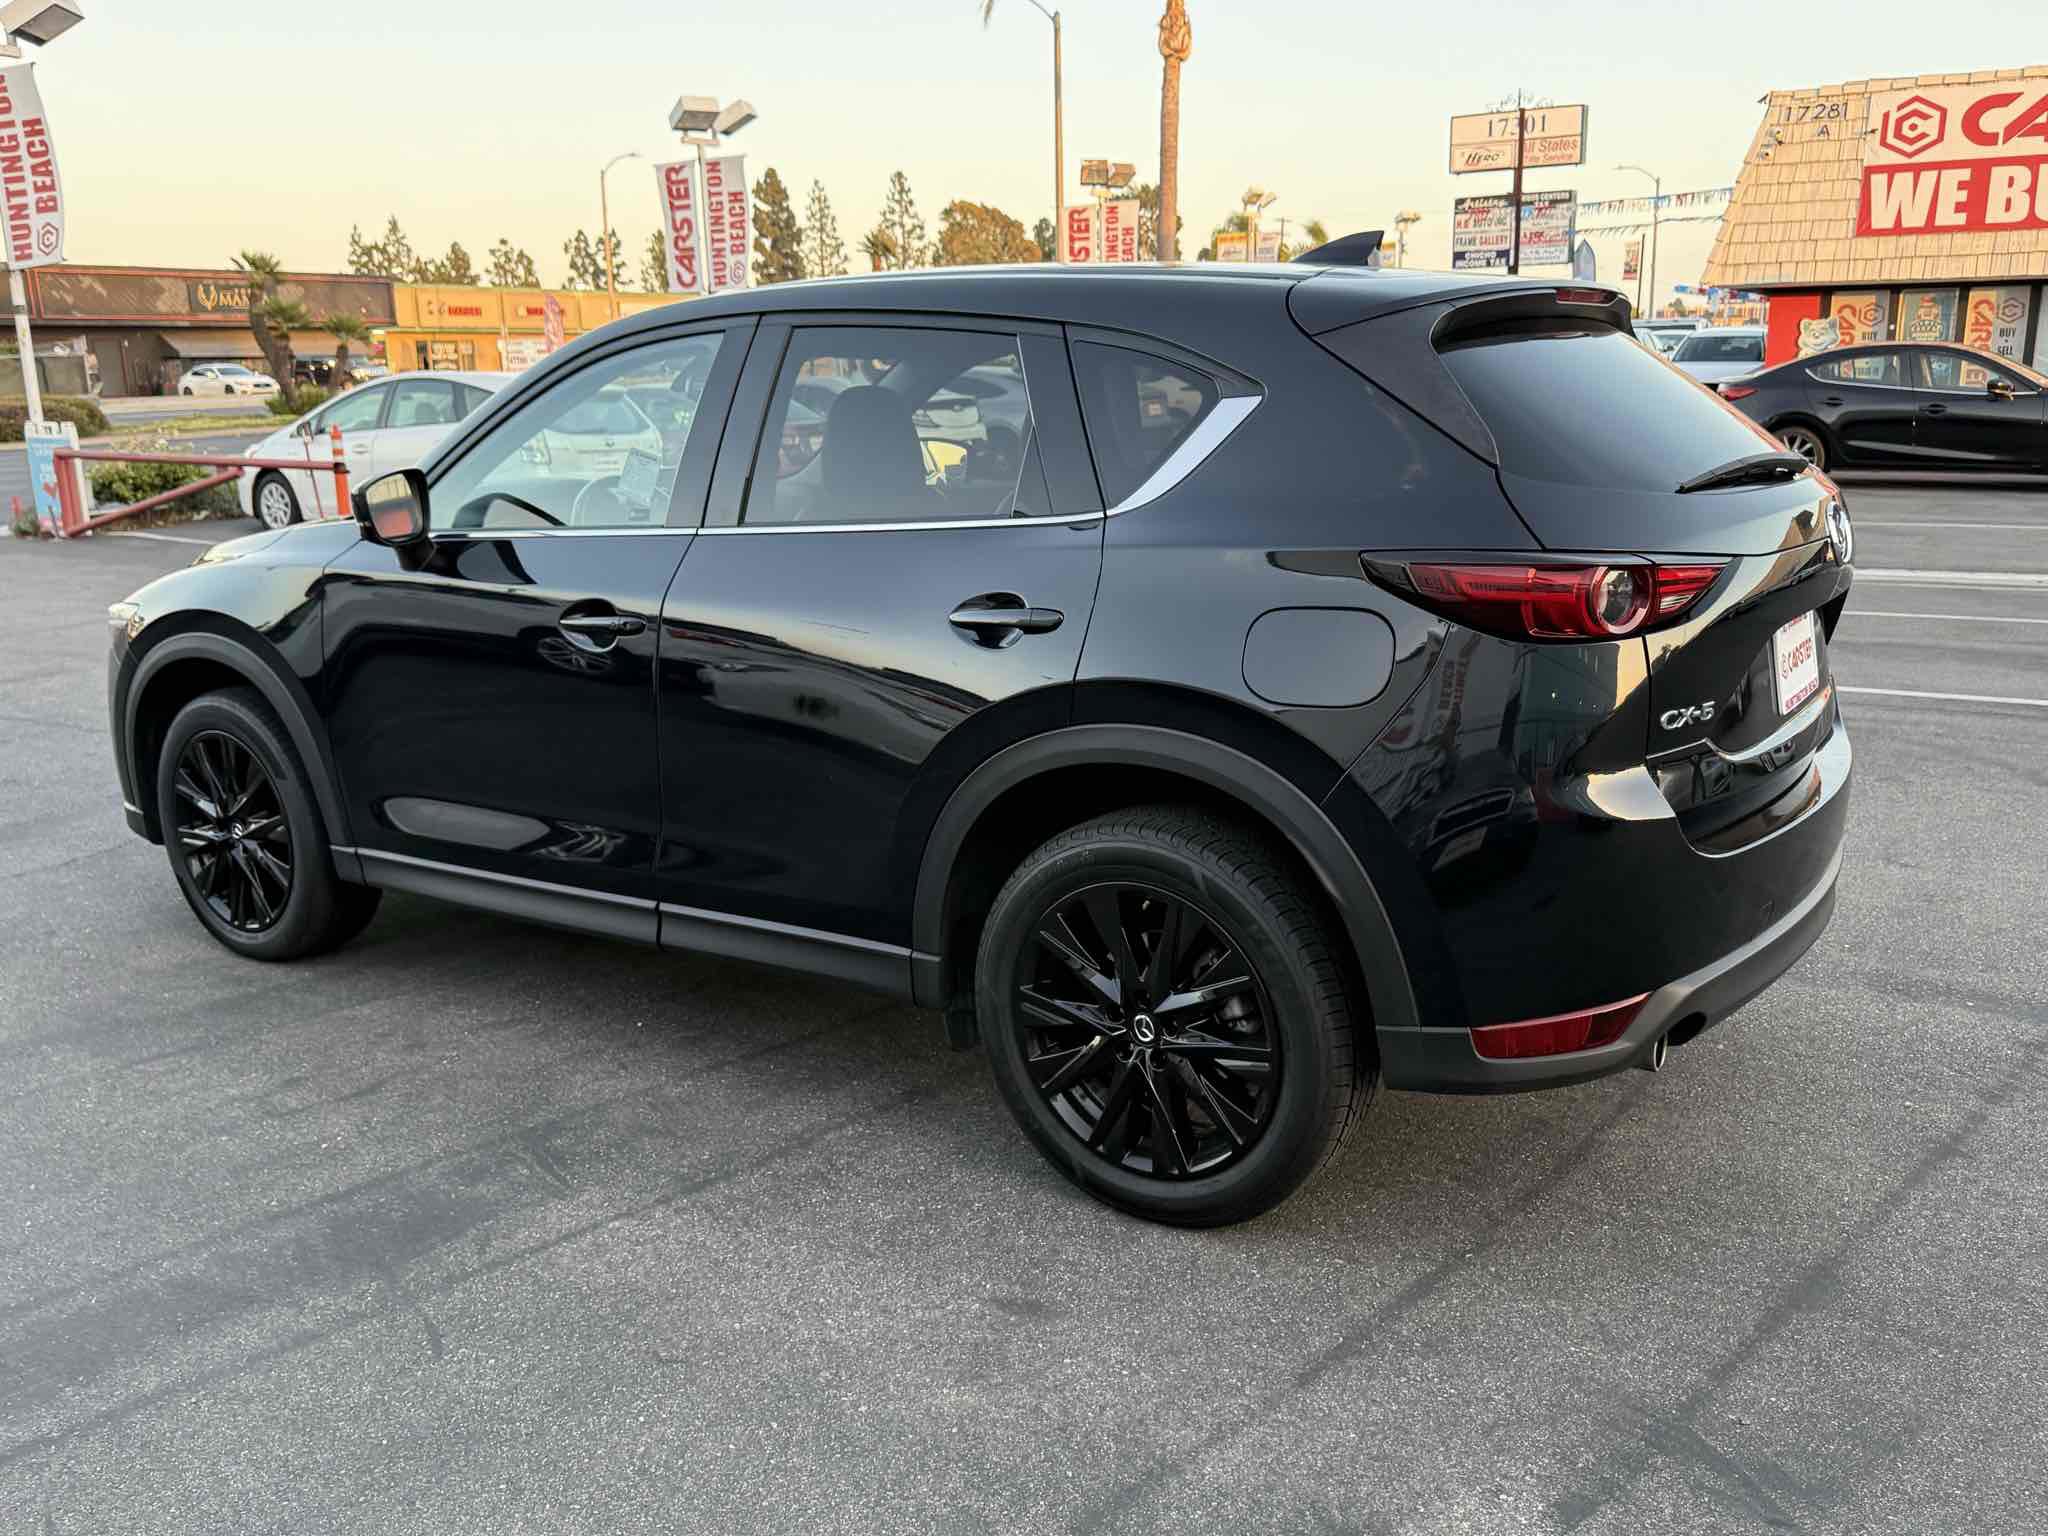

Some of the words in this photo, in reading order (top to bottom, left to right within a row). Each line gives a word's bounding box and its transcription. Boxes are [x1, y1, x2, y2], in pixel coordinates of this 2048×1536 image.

[1786, 102, 1848, 122] 17281
[22, 117, 58, 214] BEACH
[1538, 139, 1578, 153] States
[1870, 167, 1972, 231] WE
[1984, 164, 2048, 225] B
[665, 163, 697, 289] CARSTER
[705, 160, 727, 287] HUNTINGTON
[728, 191, 745, 256] BEACH
[1480, 233, 1509, 246] GALLERY
[1999, 327, 2017, 338] BUY
[1660, 700, 1716, 730] CX-5
